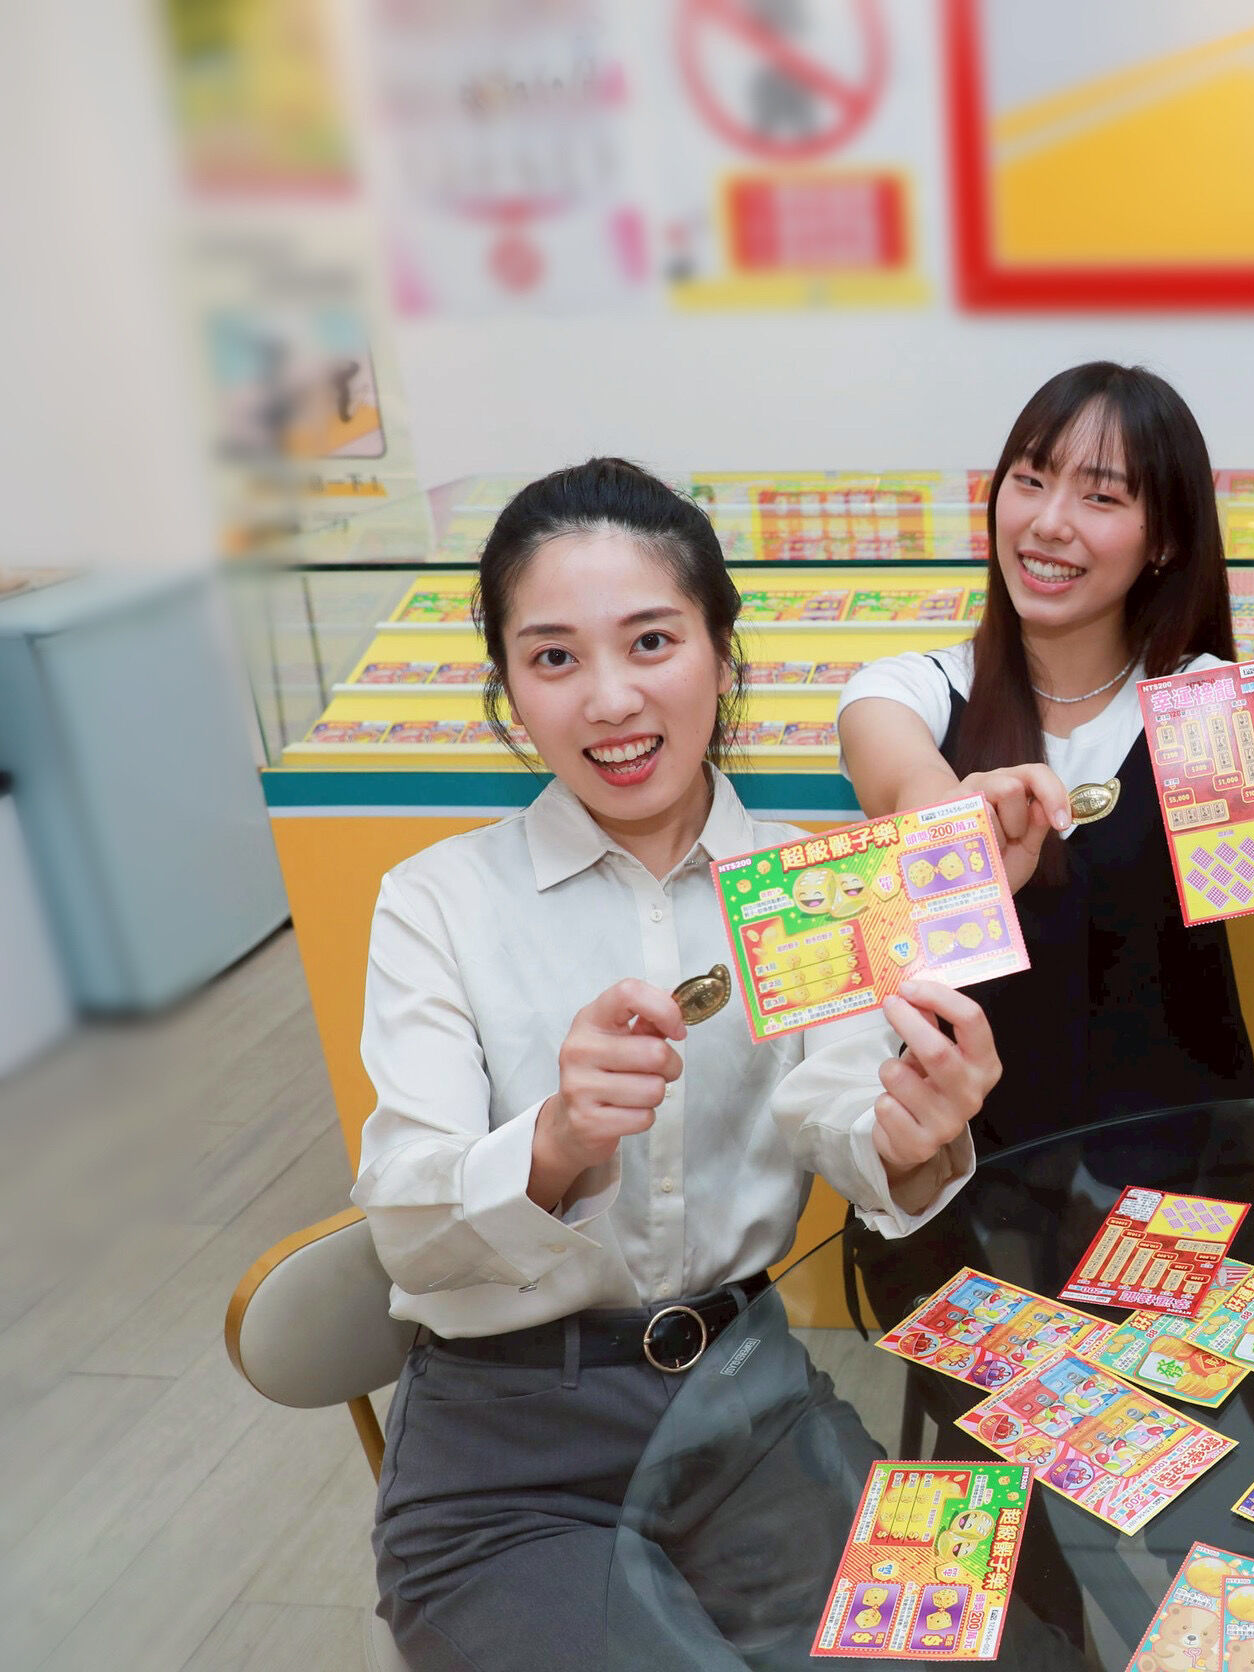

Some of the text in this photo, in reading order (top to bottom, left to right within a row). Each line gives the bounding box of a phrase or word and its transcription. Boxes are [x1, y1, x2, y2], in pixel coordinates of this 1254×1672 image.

[1151, 679, 1236, 713] 幸運接龍
[718, 859, 752, 873] NT$200
[780, 820, 899, 874] 超級骰子樂
[982, 1507, 1023, 1591] 超級骰子樂
